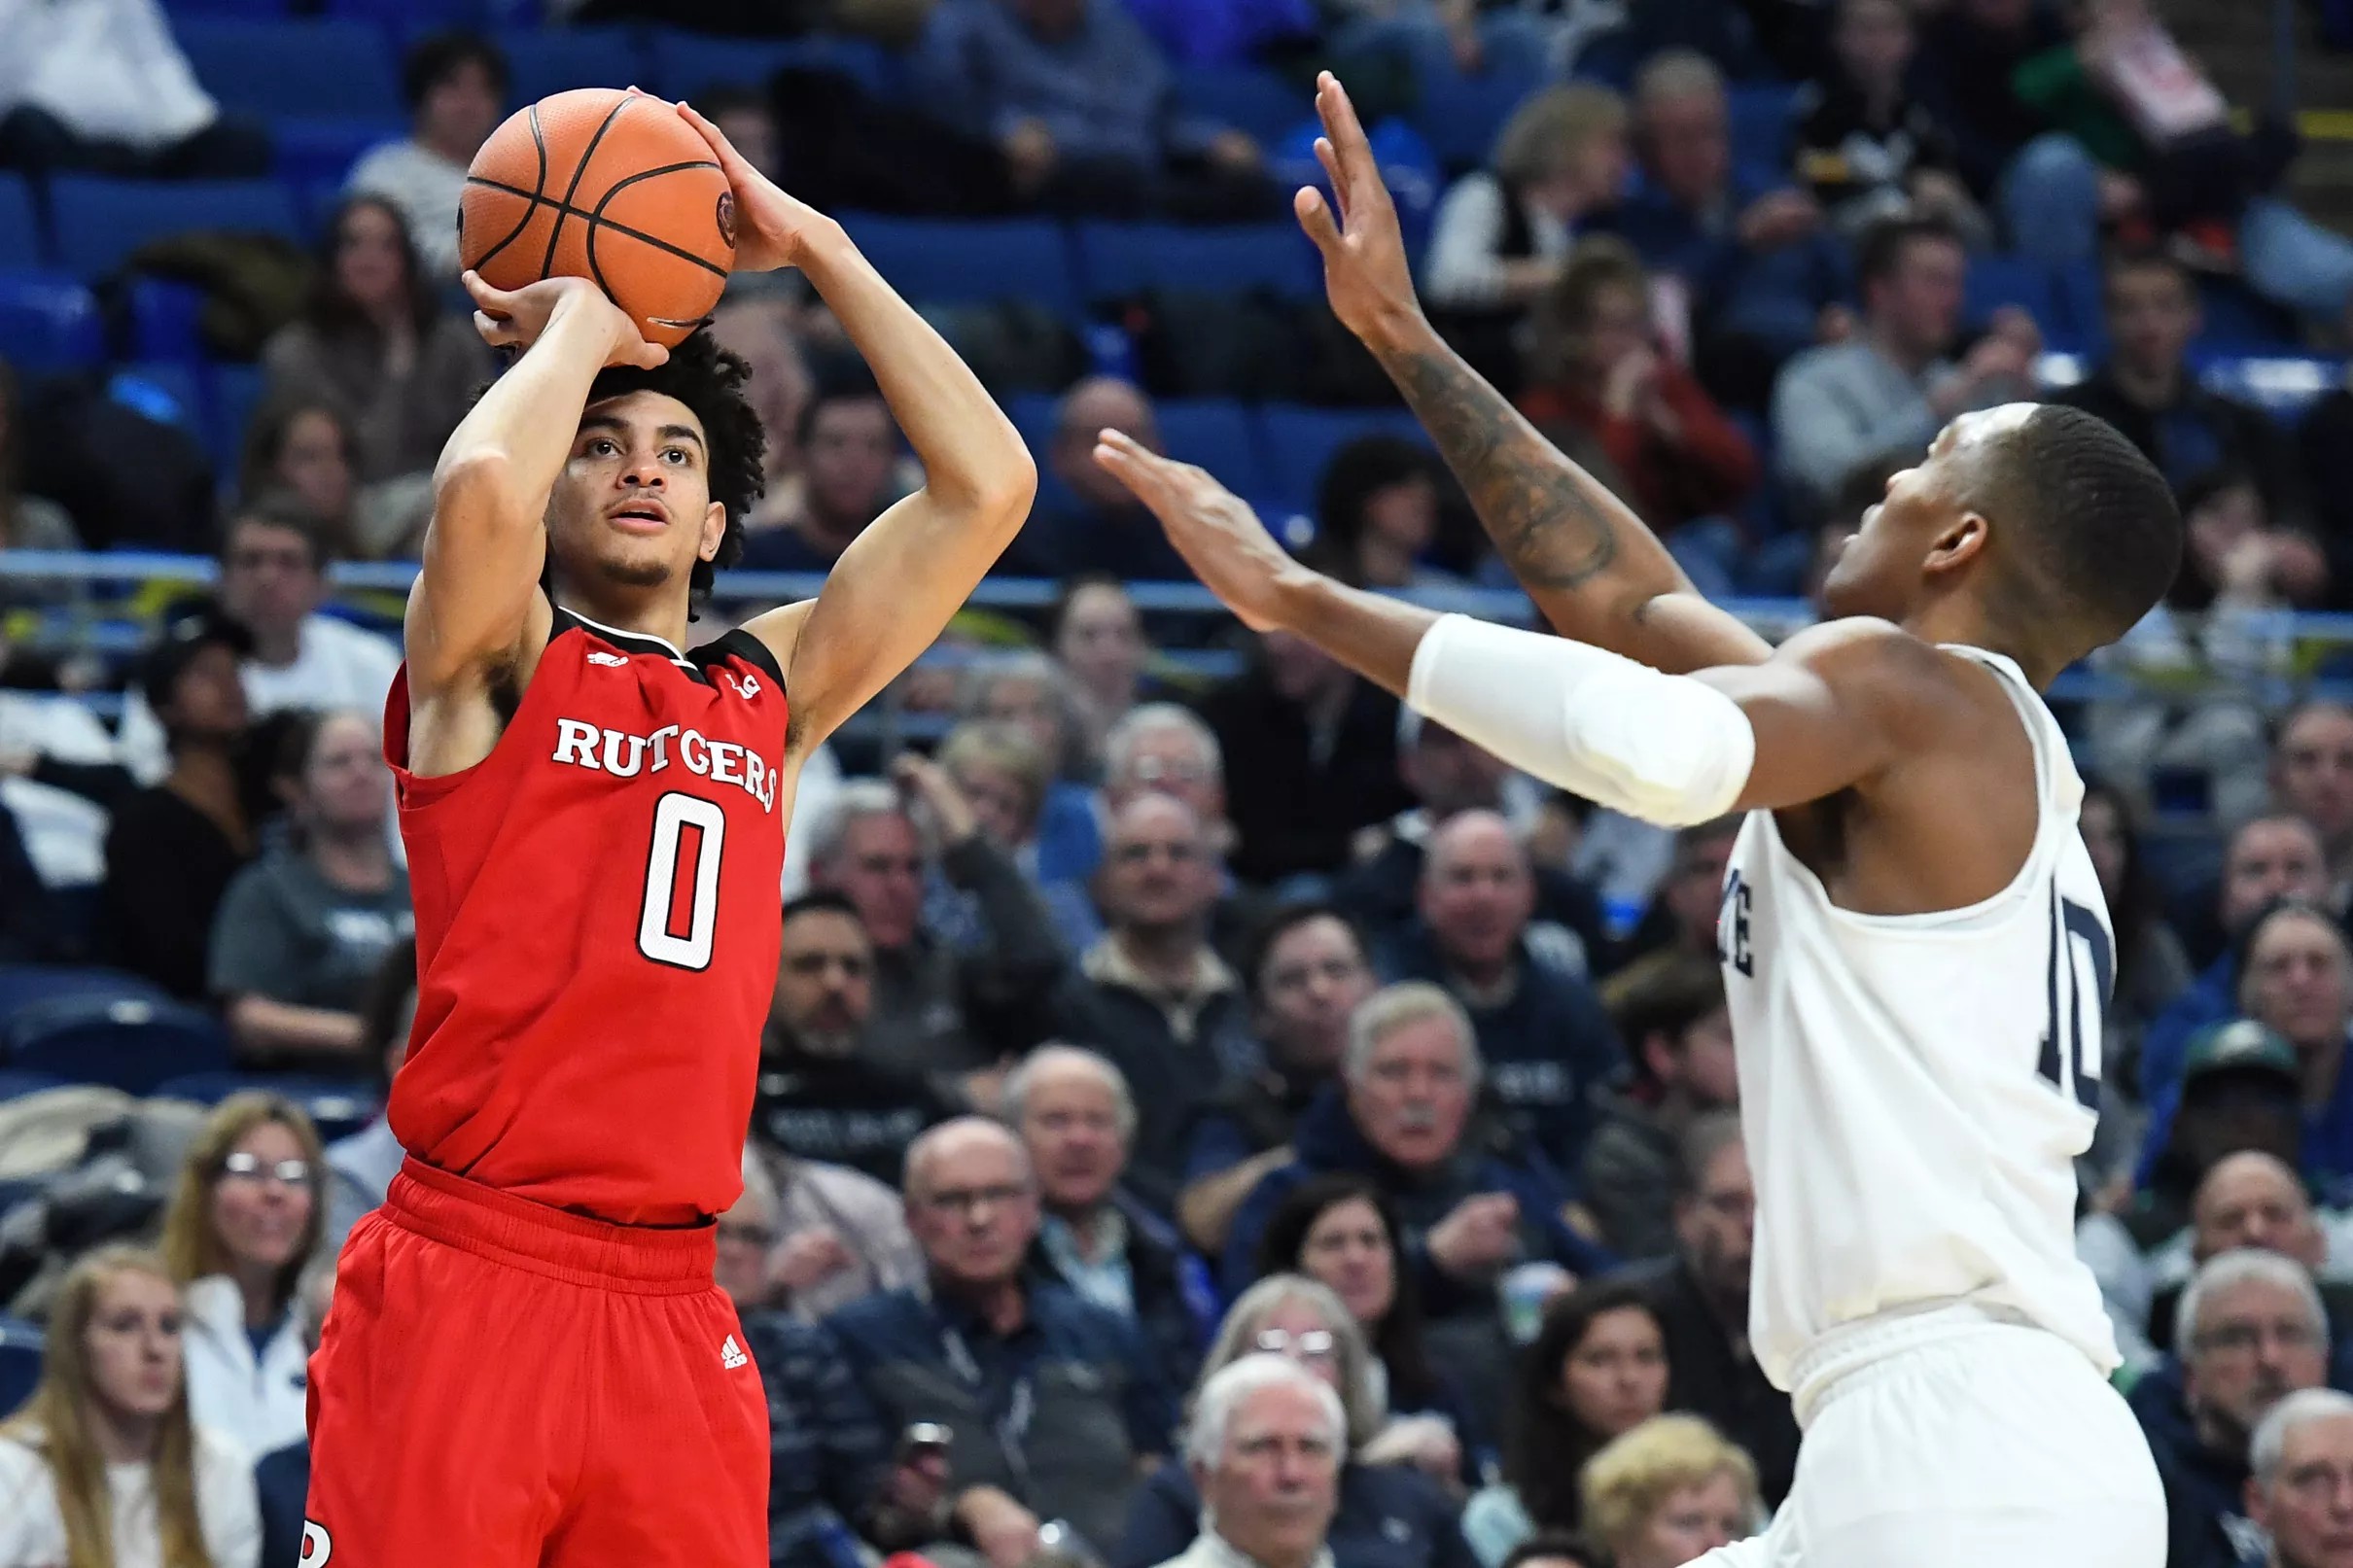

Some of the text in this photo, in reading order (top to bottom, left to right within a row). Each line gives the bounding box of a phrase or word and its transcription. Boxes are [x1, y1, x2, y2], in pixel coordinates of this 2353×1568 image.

[552, 717, 778, 814] RUTGERS
[637, 791, 725, 972] 0
[2036, 873, 2115, 1111] 10
